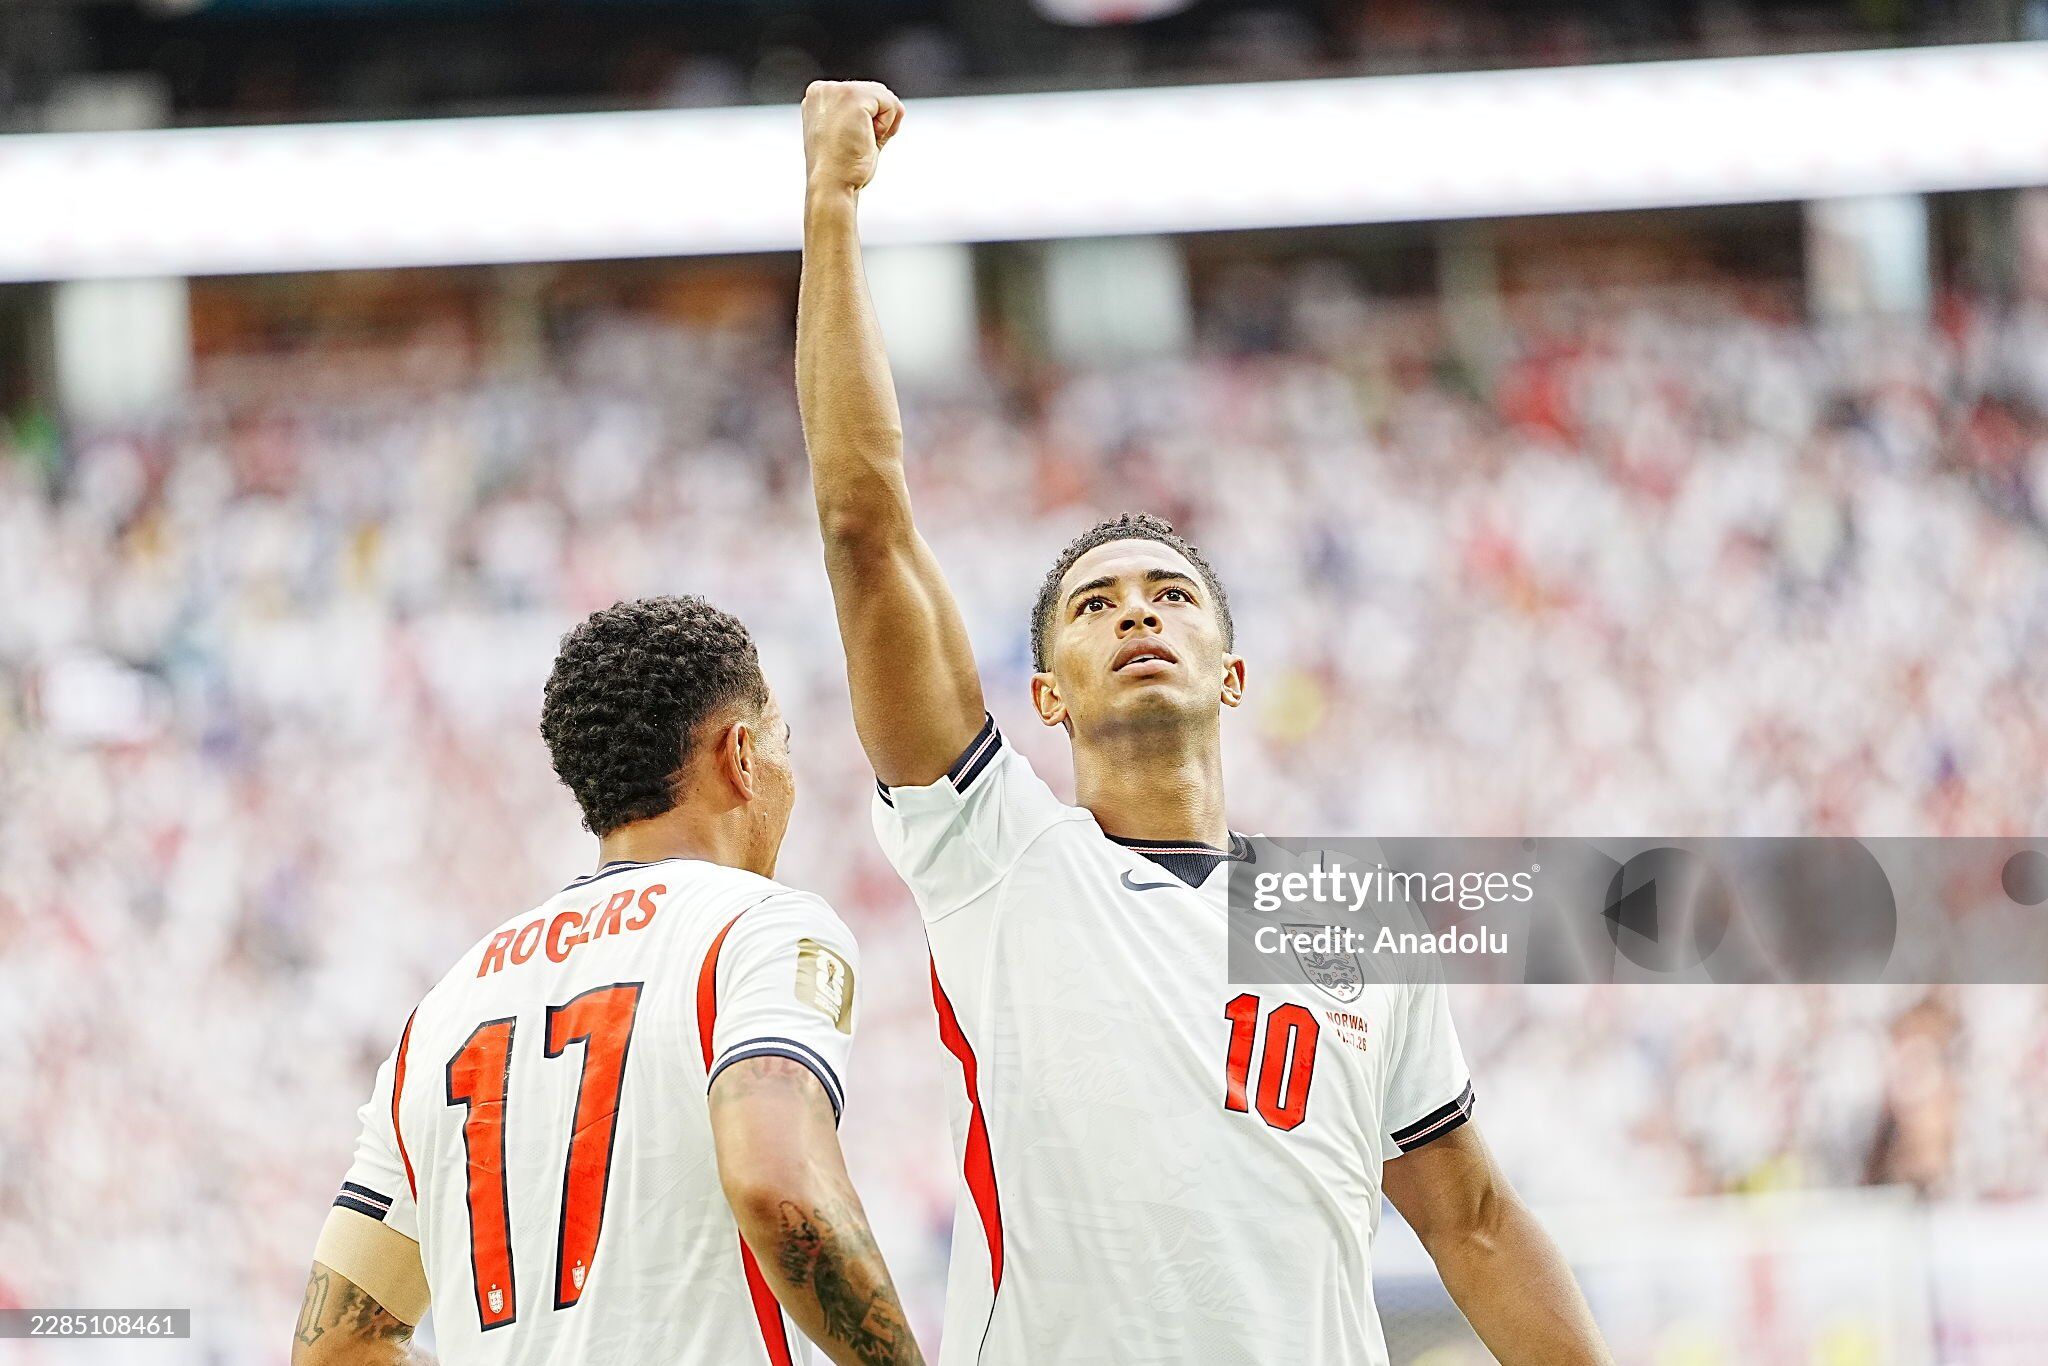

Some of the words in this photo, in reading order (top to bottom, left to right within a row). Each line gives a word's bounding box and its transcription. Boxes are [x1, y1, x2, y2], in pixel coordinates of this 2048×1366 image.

[1224, 992, 1321, 1132] 10
[1326, 1011, 1368, 1033] NORWAY
[445, 981, 645, 1333] 17
